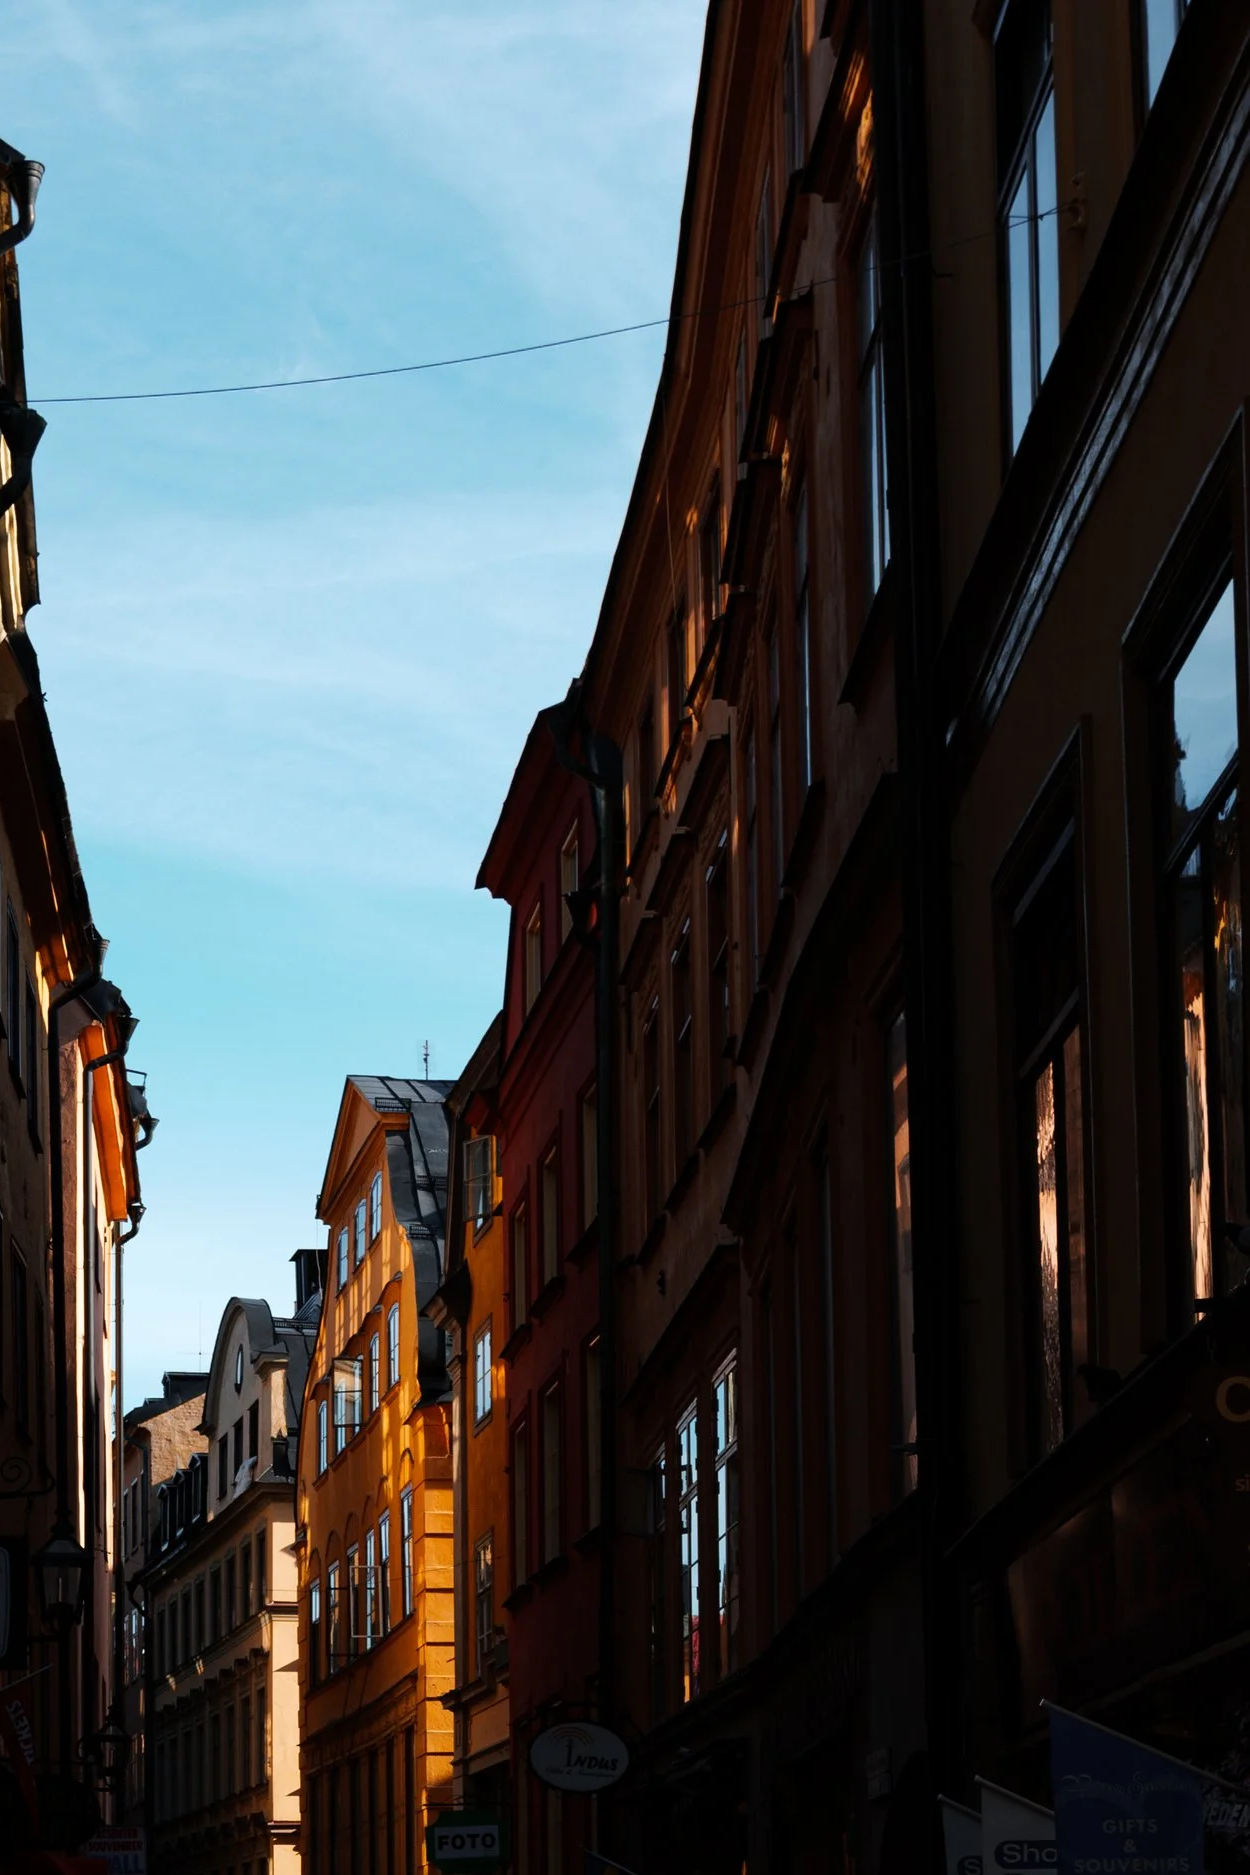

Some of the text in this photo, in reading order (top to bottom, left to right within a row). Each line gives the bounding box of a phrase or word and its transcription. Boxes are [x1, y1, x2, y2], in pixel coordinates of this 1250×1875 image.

[1102, 1818, 1159, 1835] GIFTS
[437, 1832, 496, 1851] FOTO
[1122, 1837, 1139, 1854] &
[1001, 1843, 1059, 1864] Sho
[1073, 1857, 1191, 1874] SOUVENIRS
